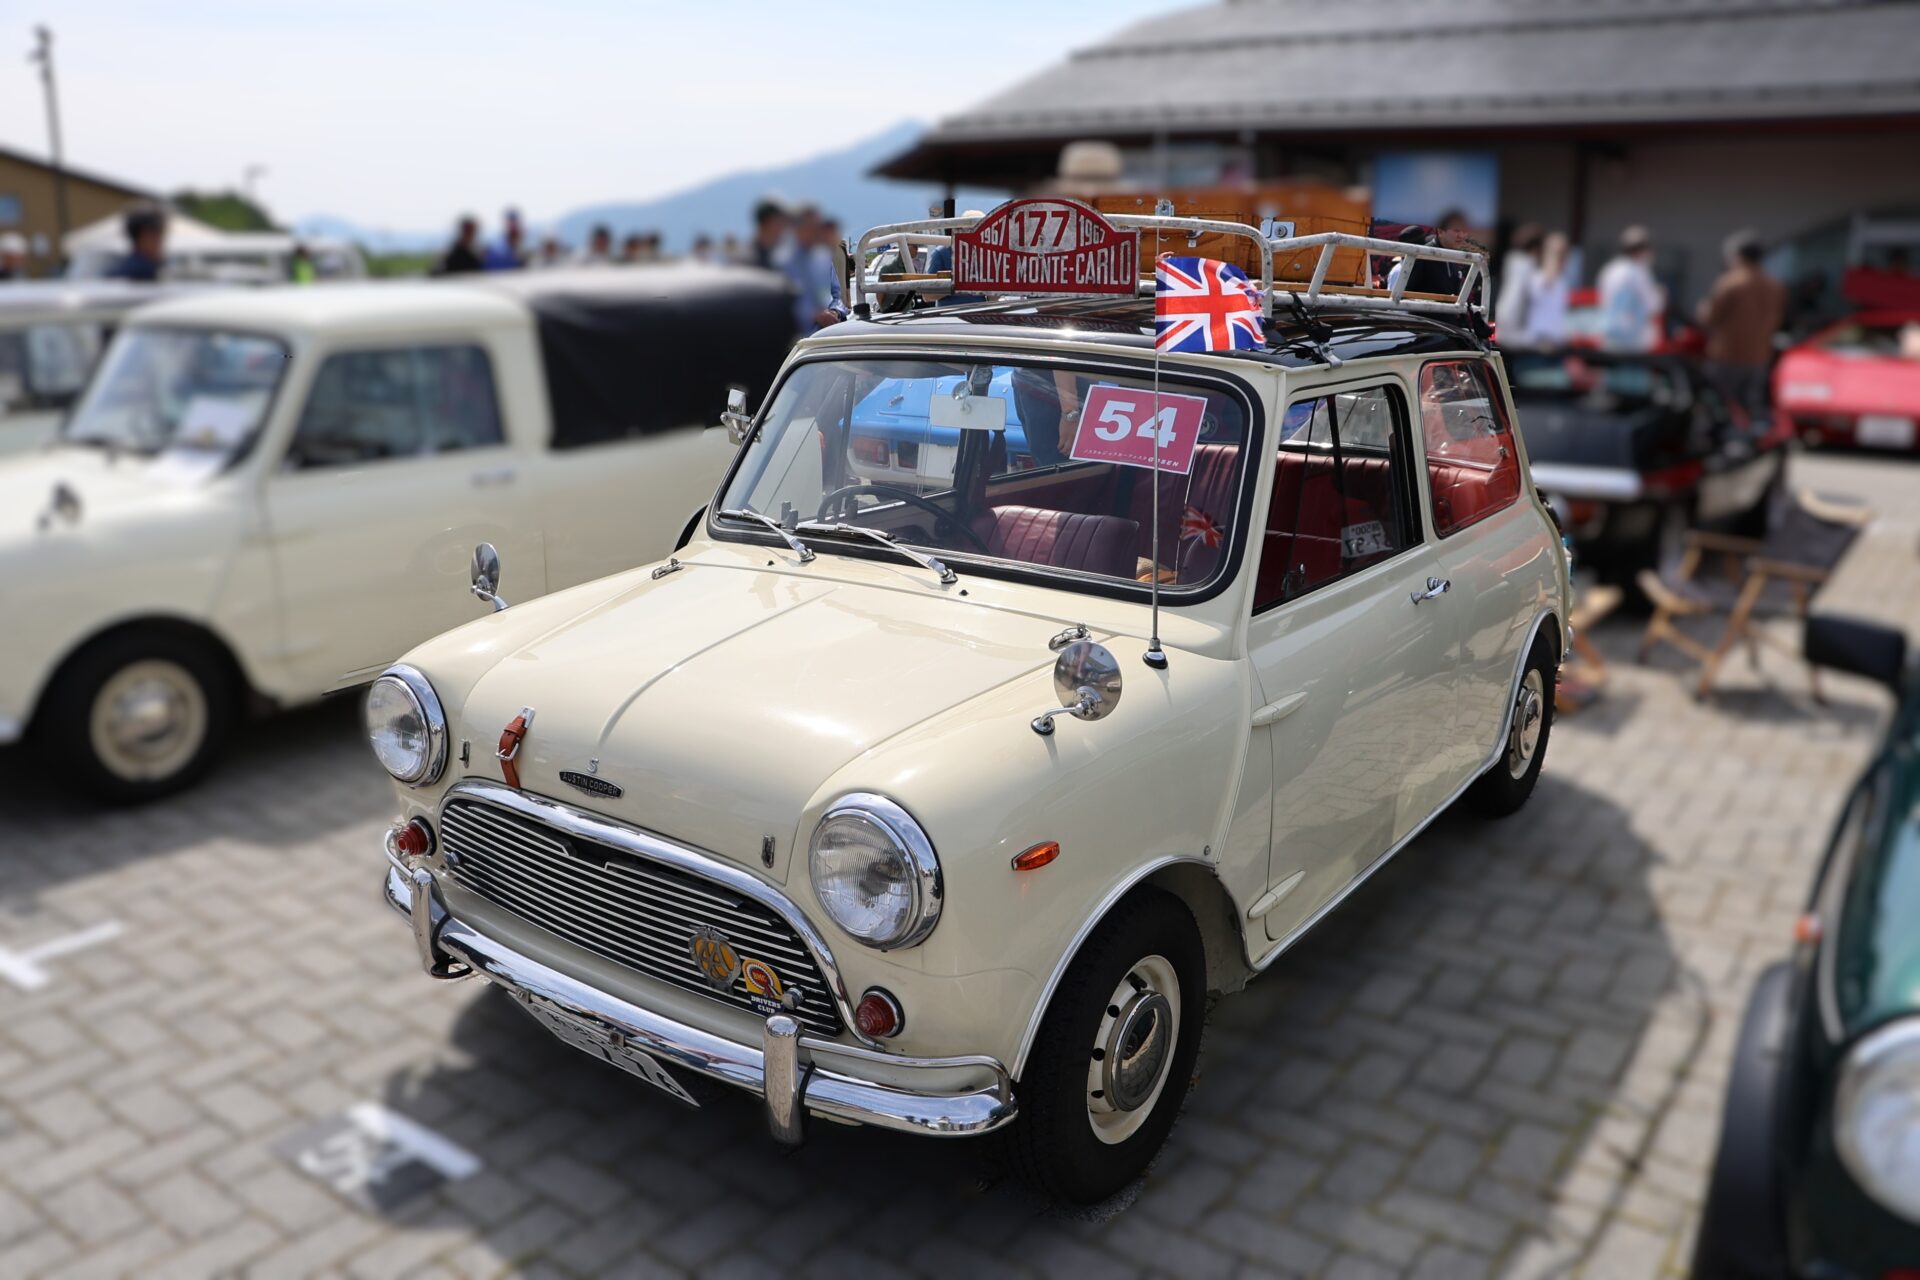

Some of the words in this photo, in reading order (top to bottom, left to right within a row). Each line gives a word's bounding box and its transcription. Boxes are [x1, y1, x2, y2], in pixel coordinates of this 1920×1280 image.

[980, 215, 1007, 246] 1967
[1014, 210, 1070, 247] 177
[1079, 215, 1105, 246] 1967
[959, 240, 1010, 283] RALLYE
[1016, 240, 1131, 285] MONTE-CARLO
[1094, 400, 1177, 448] 54
[1147, 456, 1179, 467] GSEN
[587, 758, 599, 773] S
[562, 772, 588, 787] AUSTIN
[589, 780, 619, 795] COOPER
[751, 995, 781, 1008] DRIVERS
[757, 1005, 776, 1014] CLUB
